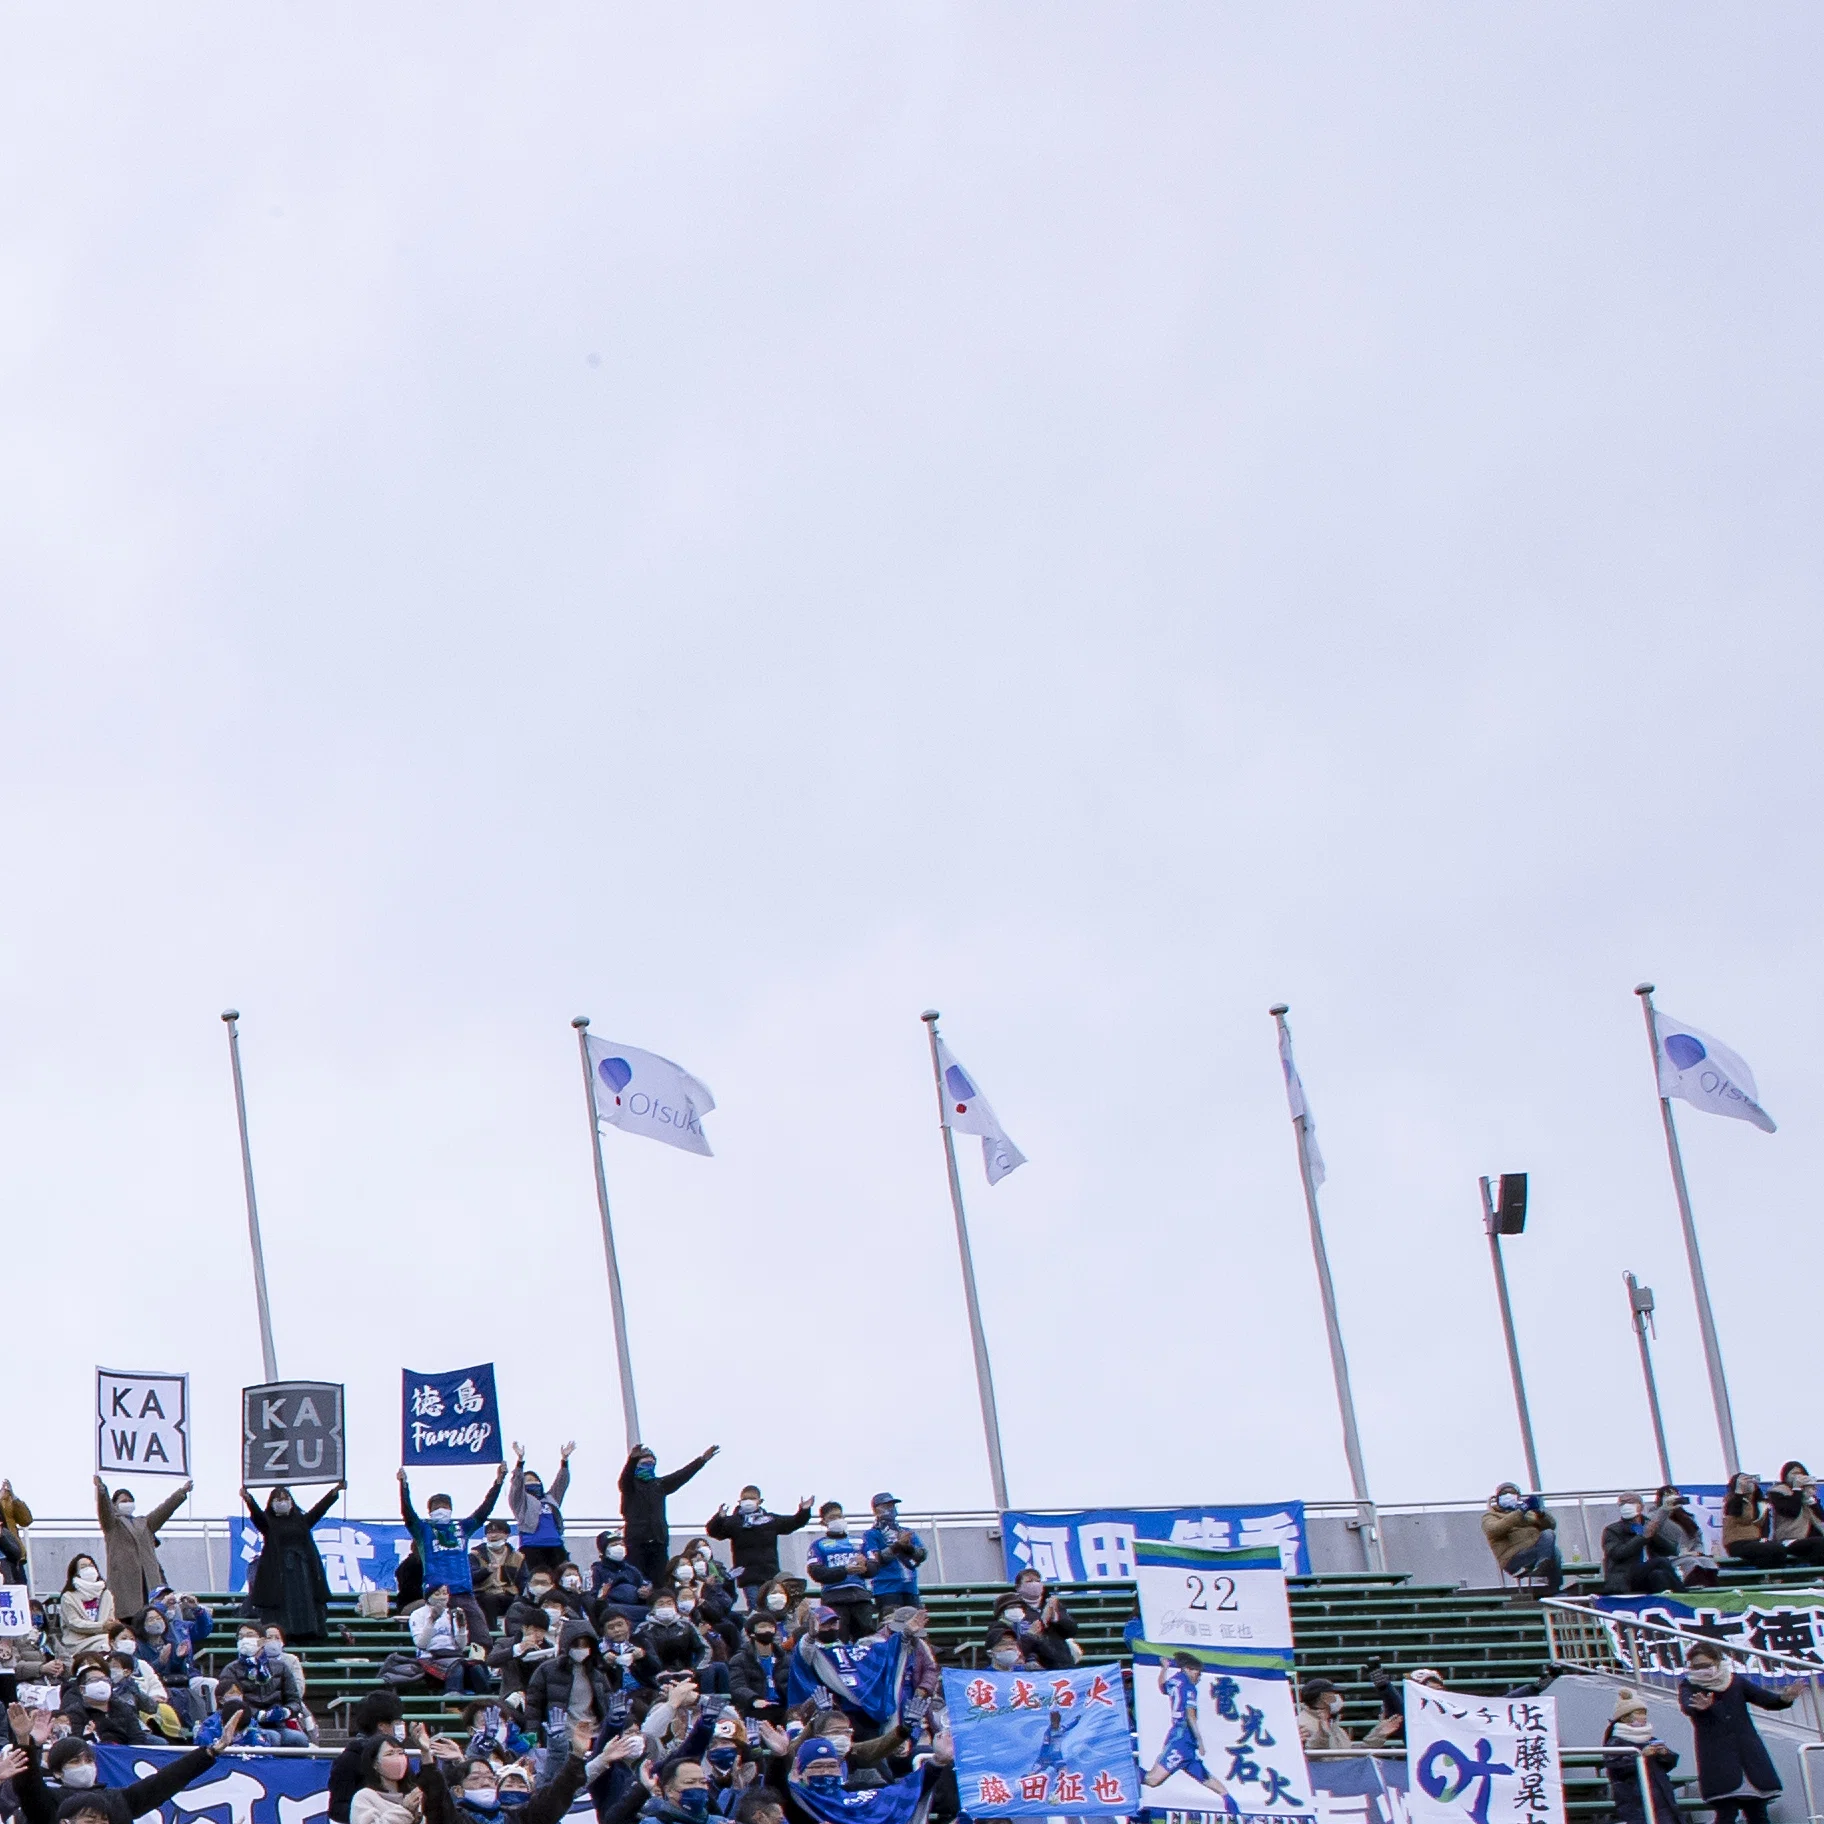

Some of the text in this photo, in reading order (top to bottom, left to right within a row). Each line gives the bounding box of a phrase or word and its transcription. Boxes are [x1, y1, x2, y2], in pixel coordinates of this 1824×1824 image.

[409, 1377, 485, 1417] 徳島
[410, 1422, 493, 1455] Family
[1185, 1575, 1239, 1612] 22
[1210, 1676, 1305, 1808] 電光石火
[978, 1770, 1126, 1805] 藤田征也
